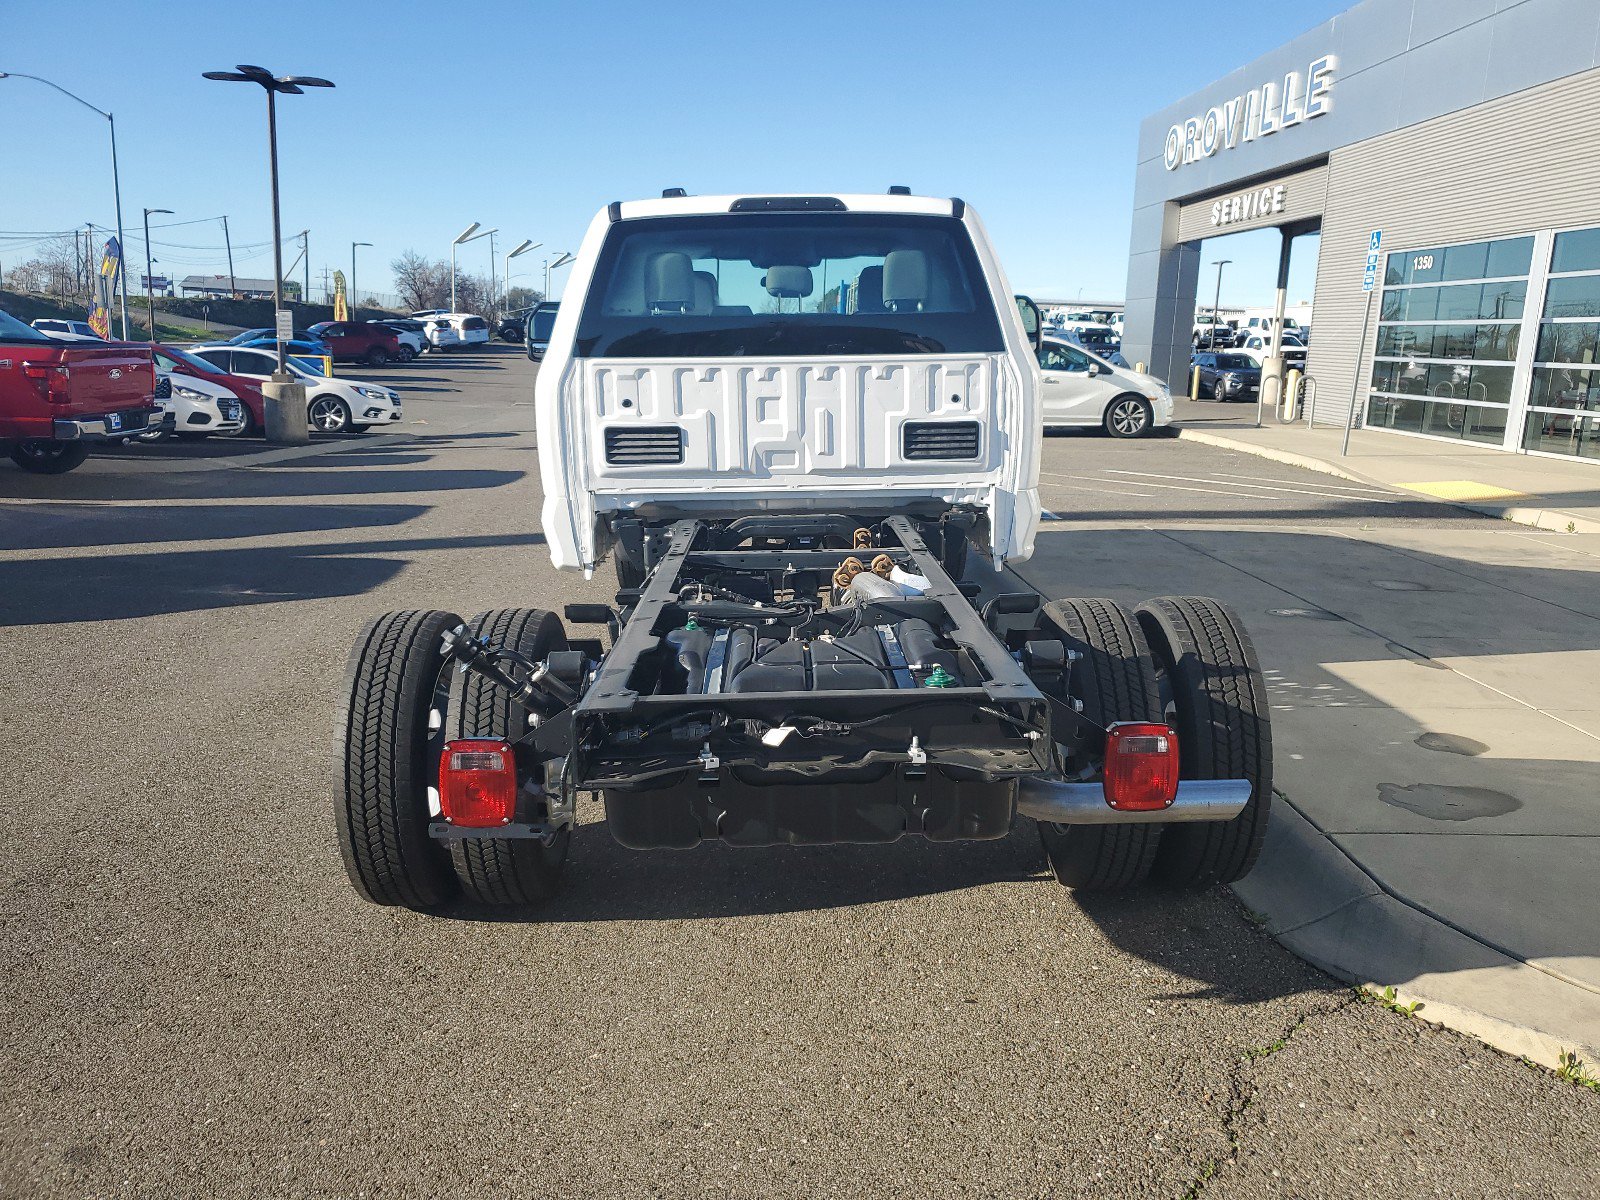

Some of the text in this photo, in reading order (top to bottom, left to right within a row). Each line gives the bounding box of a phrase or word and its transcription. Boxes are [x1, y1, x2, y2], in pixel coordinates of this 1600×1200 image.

[1164, 54, 1336, 171] OROVILLE
[1210, 184, 1286, 226] SERVICE
[1413, 255, 1434, 270] 1350
